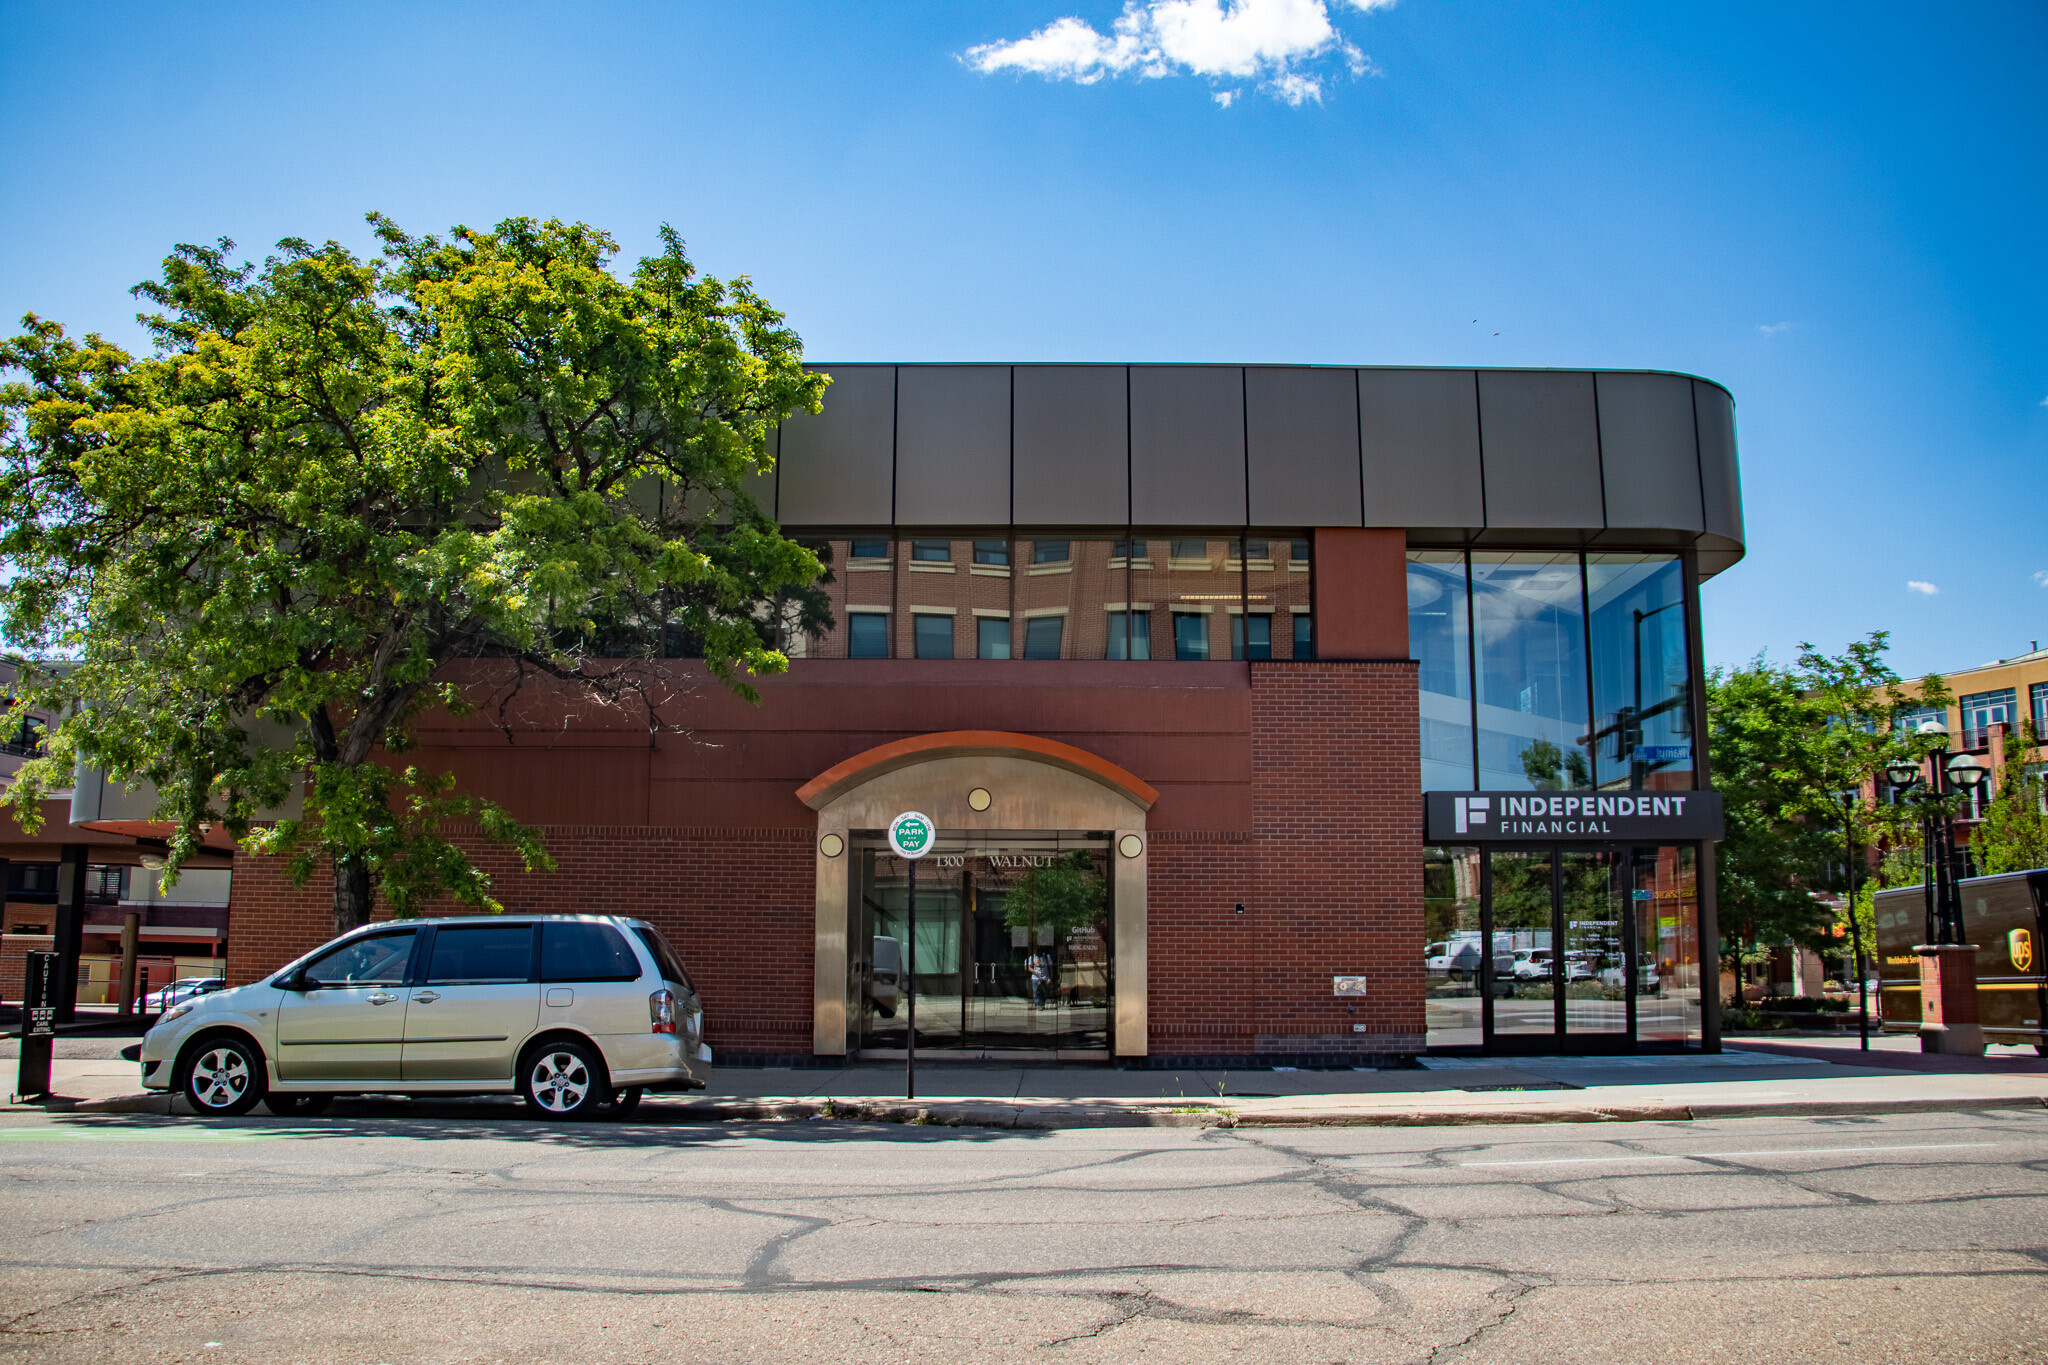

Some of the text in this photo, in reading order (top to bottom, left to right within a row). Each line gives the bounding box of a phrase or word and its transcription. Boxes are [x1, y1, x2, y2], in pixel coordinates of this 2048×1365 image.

[1500, 797, 1686, 816] INDEPENDENT
[1501, 821, 1611, 833] FINANCIAL
[937, 855, 1054, 867] 1300 WALNUT
[2013, 941, 2030, 965] ups
[41, 954, 49, 1007] CAUTION
